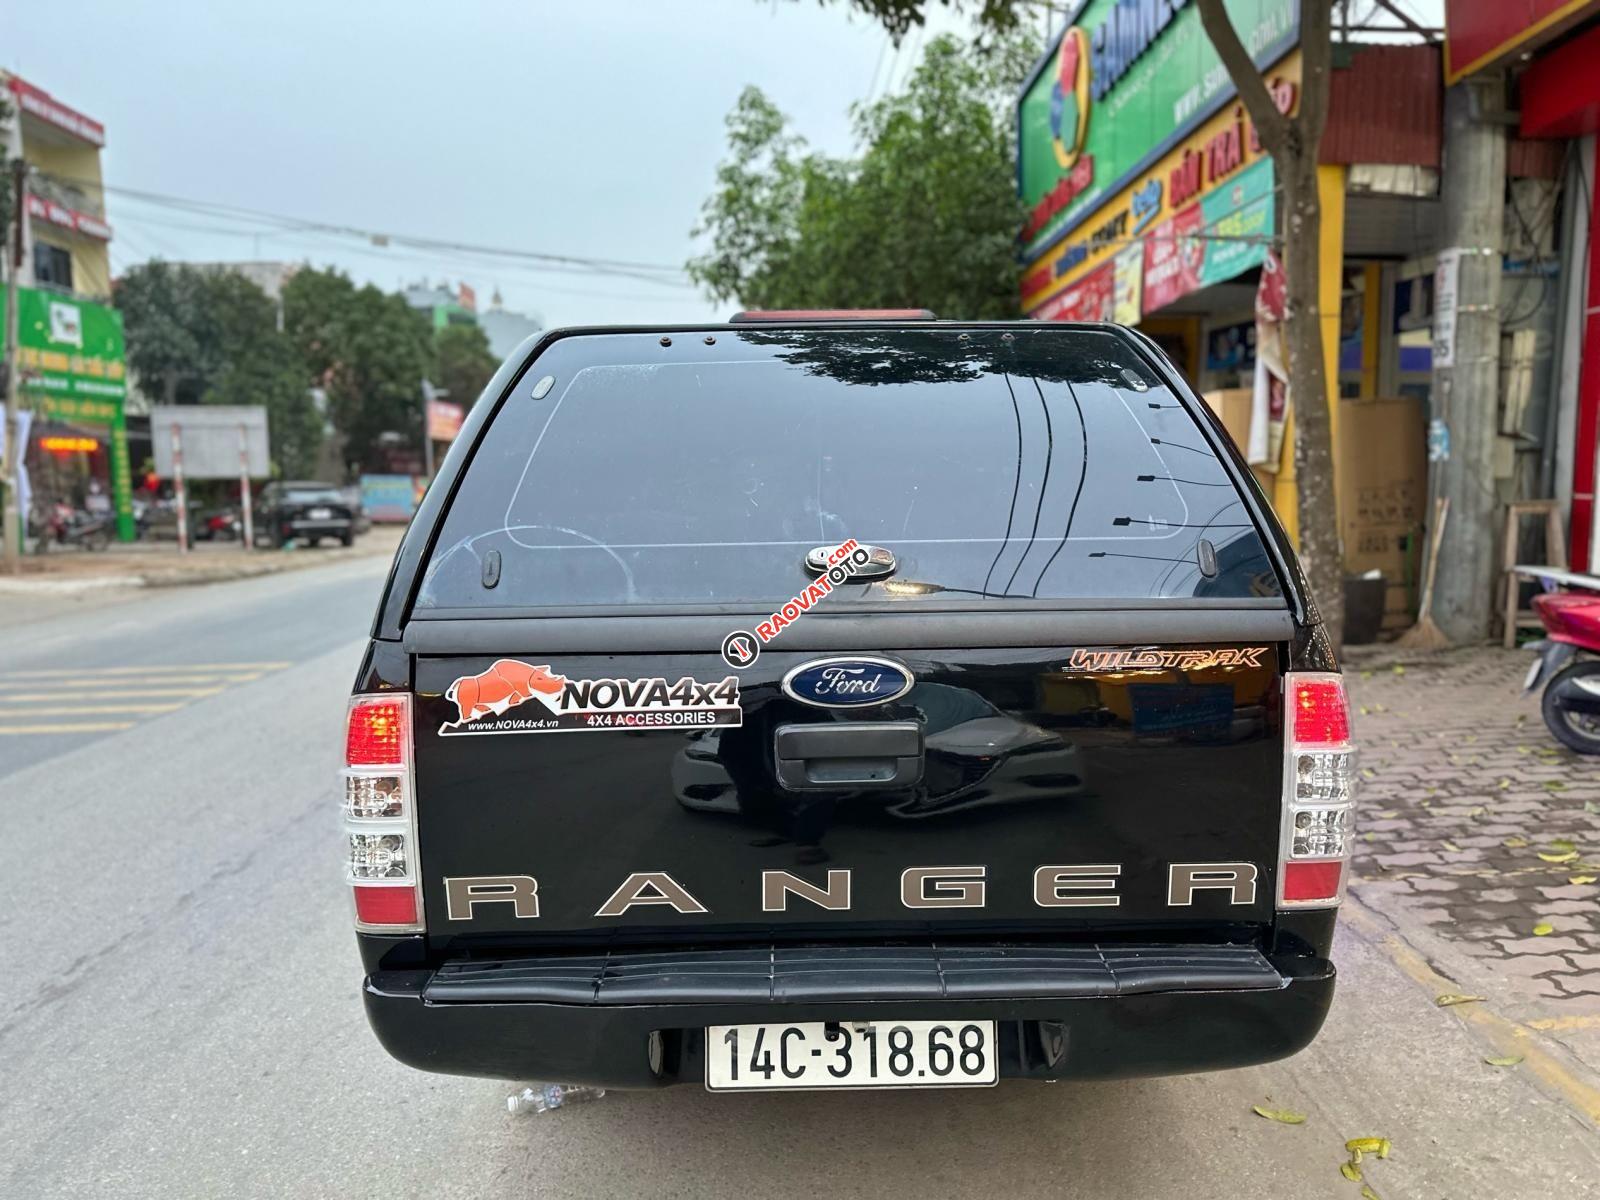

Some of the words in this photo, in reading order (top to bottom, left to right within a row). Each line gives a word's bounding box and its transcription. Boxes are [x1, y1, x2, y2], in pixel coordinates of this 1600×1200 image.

[1070, 647, 1268, 671] WILDTRAK
[560, 676, 740, 710] NOVA4x4
[814, 667, 883, 695] Ford
[467, 719, 560, 732] www.NOVA4x4.vn
[586, 713, 607, 727] 4X4
[618, 711, 716, 726] ACCESSORIES
[445, 862, 1258, 921] RANGER
[723, 1024, 986, 1081] 14C-318.68
